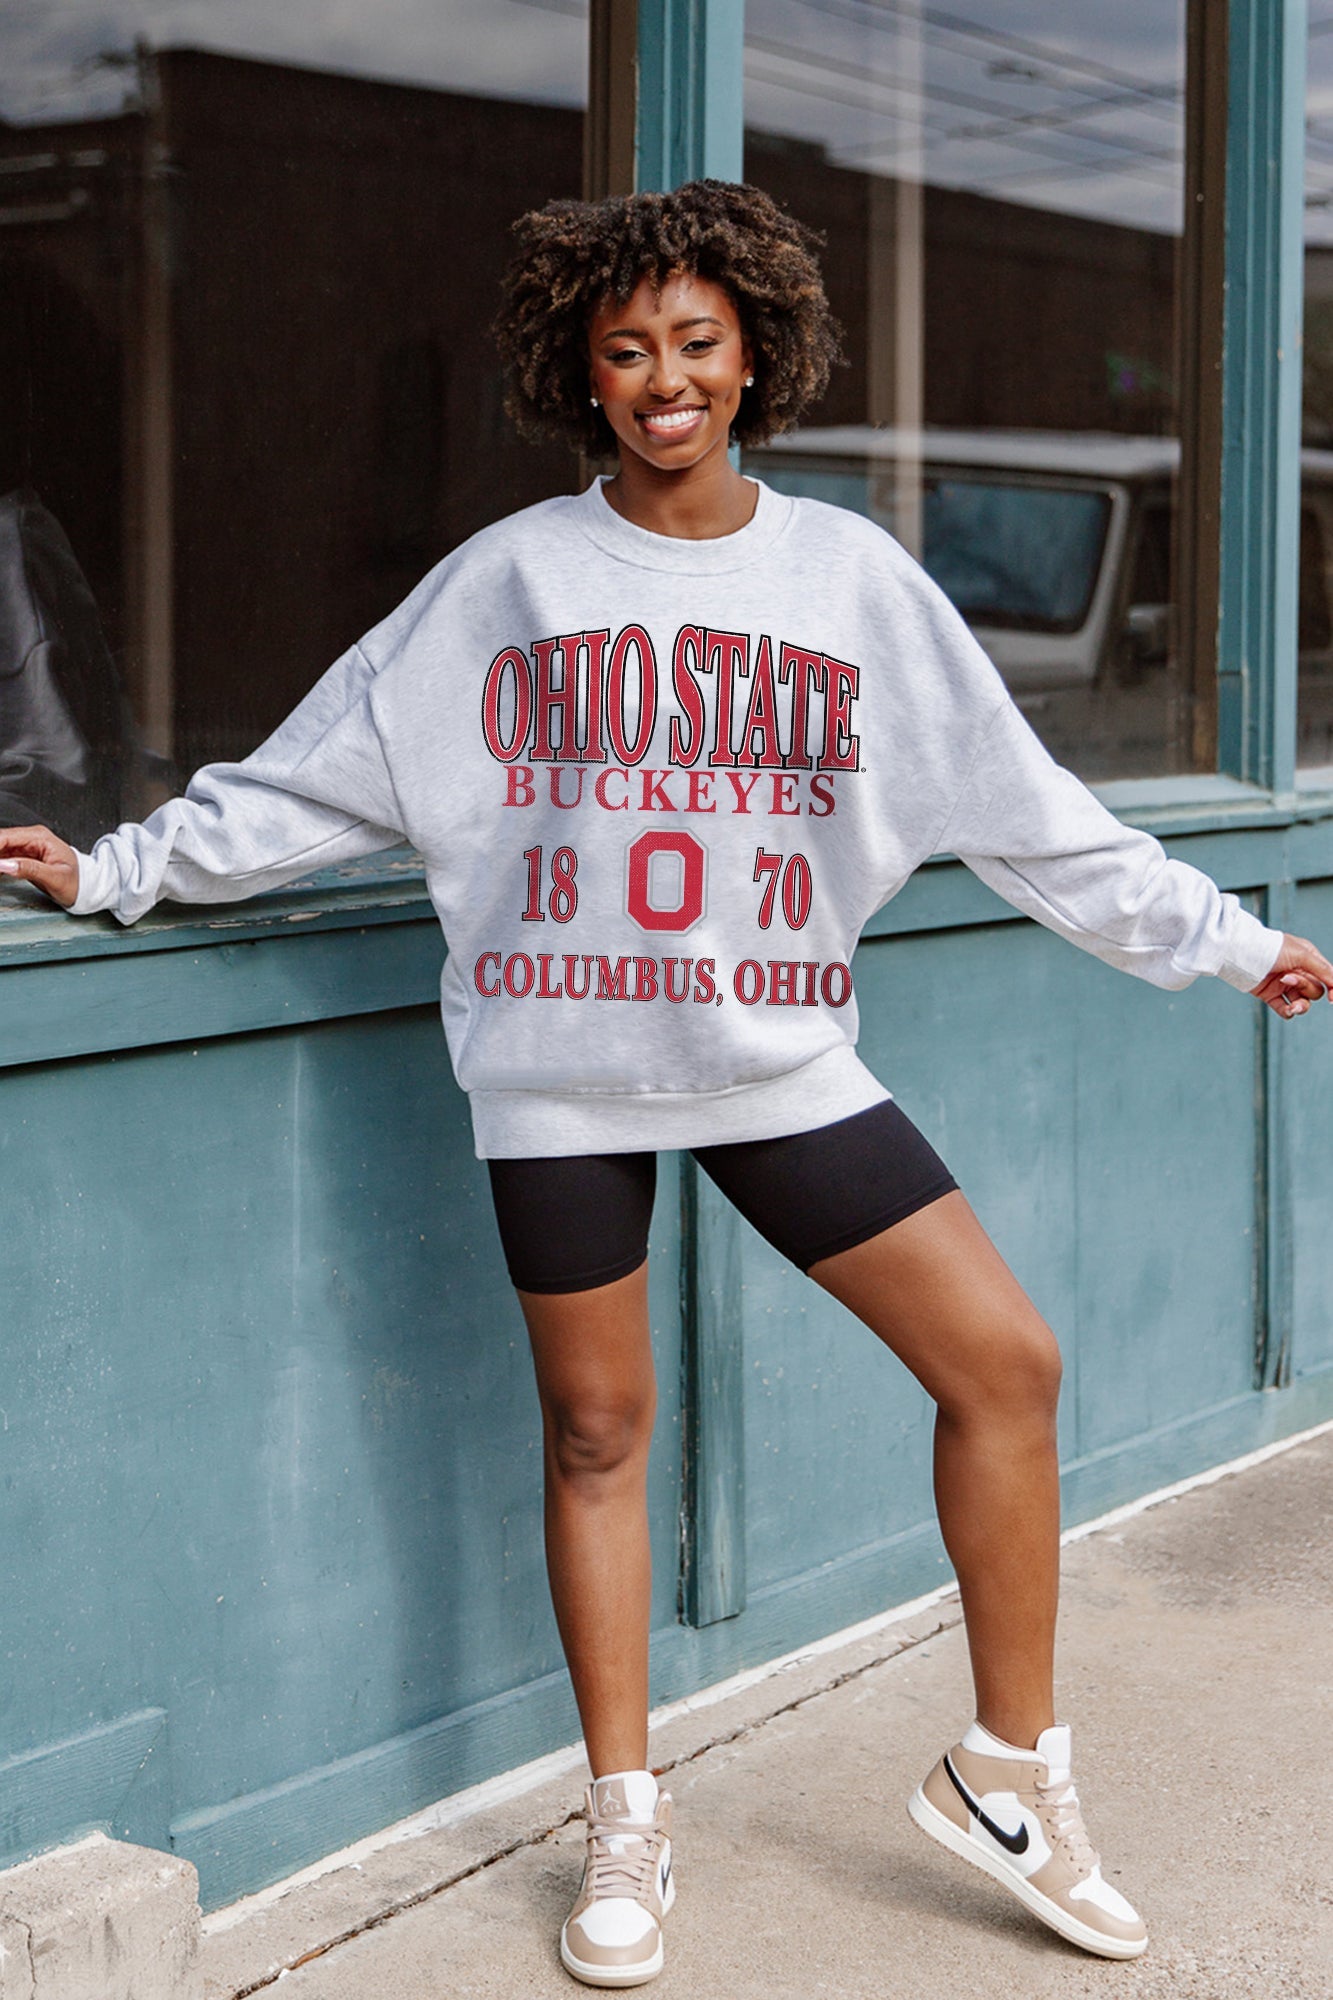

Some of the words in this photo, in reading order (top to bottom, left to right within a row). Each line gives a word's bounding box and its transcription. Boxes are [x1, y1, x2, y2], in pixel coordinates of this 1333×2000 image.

[482, 624, 659, 767] OHIO
[669, 624, 860, 772] STATE
[502, 765, 836, 816] BUCKEYES
[522, 845, 578, 923] 18
[753, 847, 812, 930] 70
[474, 951, 724, 1006] COLUMBUS,
[733, 959, 853, 1008] OHIO
